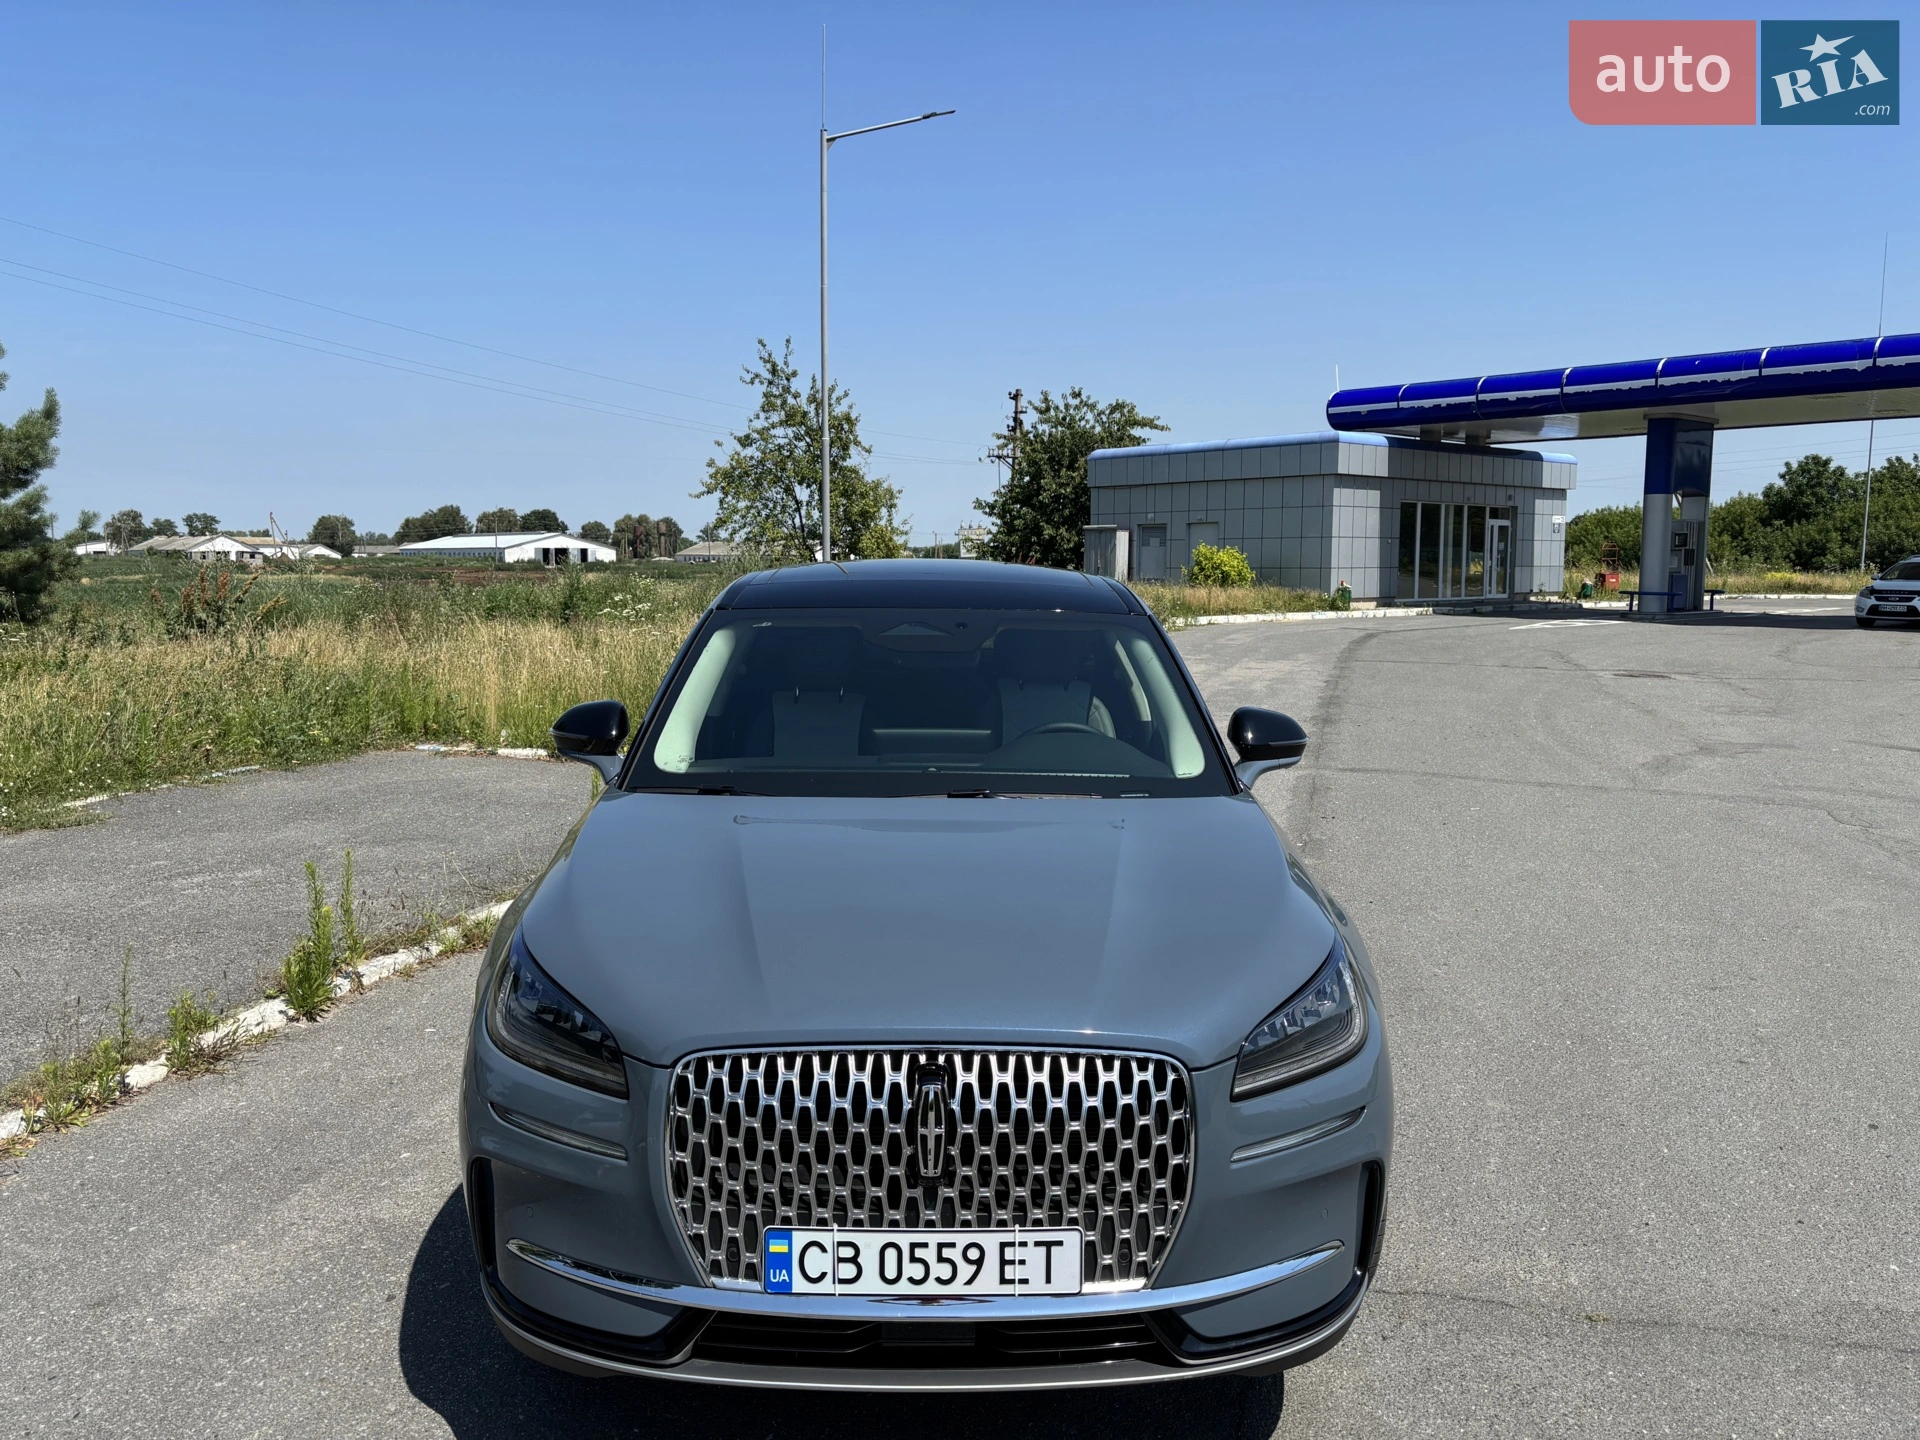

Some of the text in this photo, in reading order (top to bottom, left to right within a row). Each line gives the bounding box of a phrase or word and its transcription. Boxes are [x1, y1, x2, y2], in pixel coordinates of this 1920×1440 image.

[769, 1269, 790, 1283] UA
[798, 1240, 1064, 1286] CB 0559 ET
